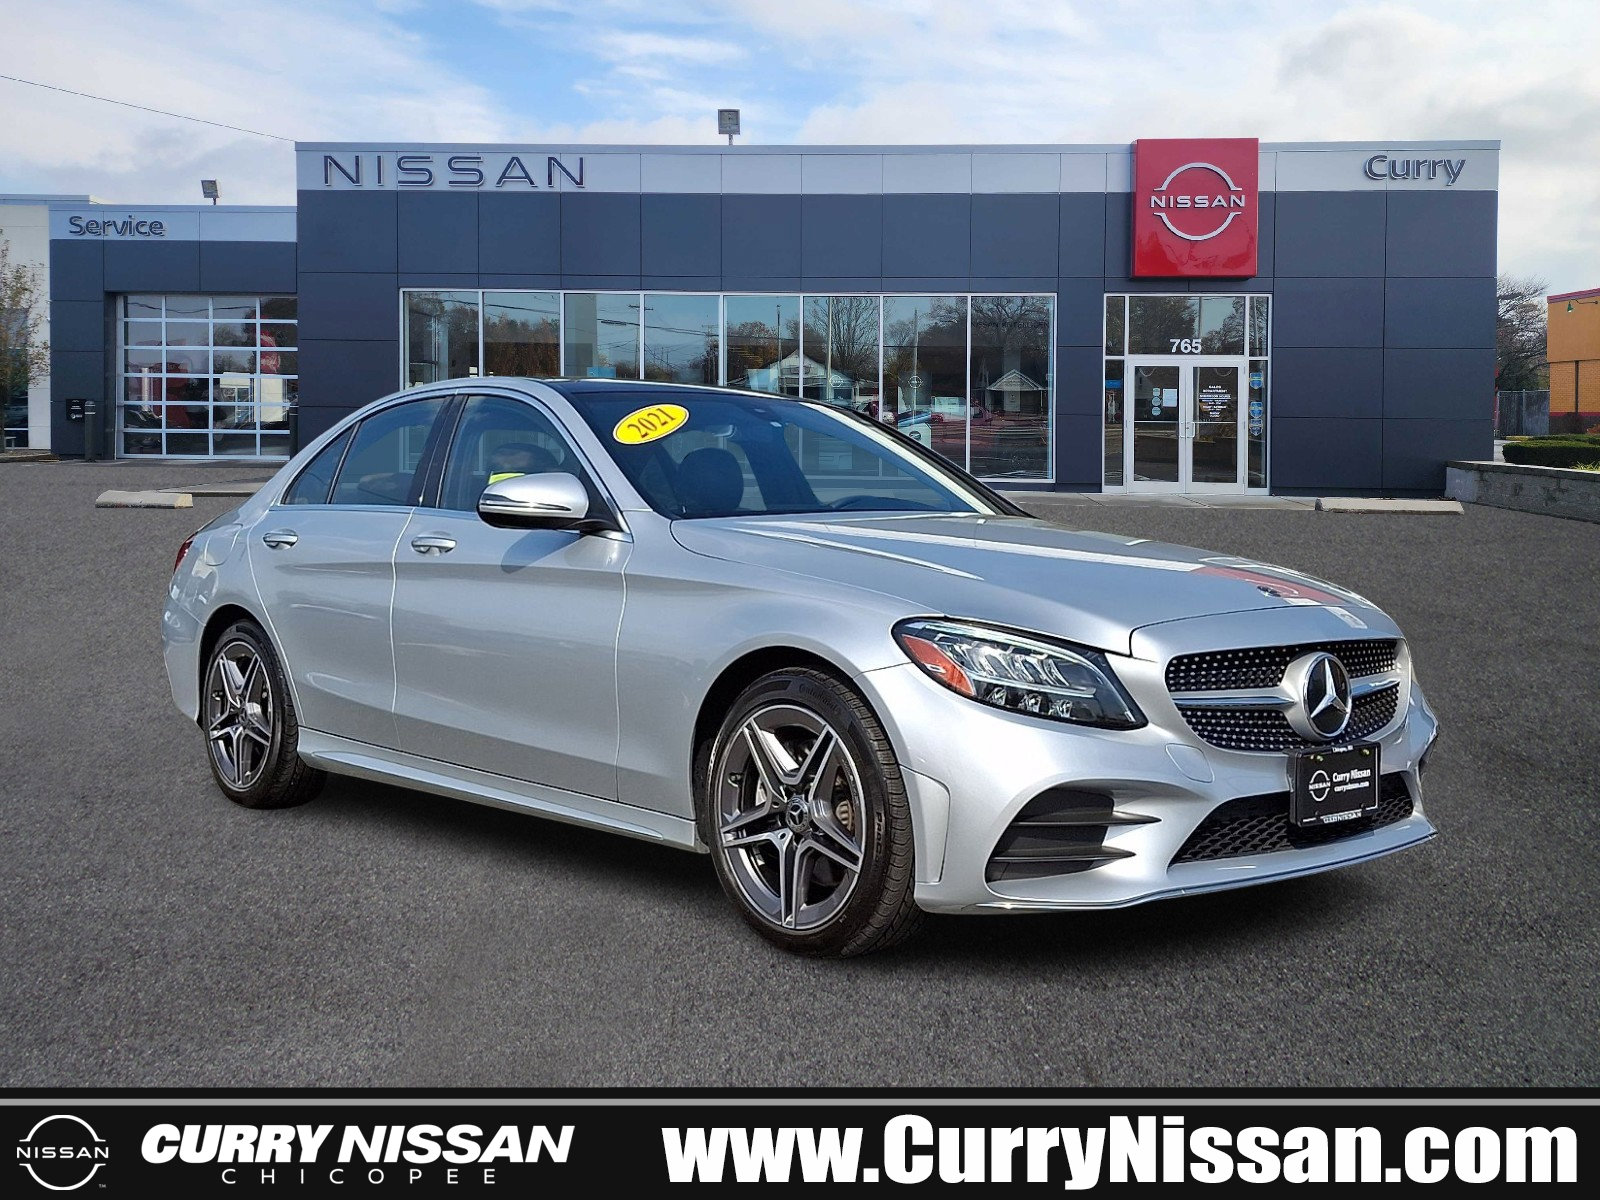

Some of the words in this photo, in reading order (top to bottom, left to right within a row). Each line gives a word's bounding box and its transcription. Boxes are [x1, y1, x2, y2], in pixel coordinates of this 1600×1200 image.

[323, 155, 586, 188] NISSAN
[1364, 154, 1466, 187] Curry
[1150, 194, 1246, 208] NISSAN
[68, 213, 165, 237] Service
[1169, 338, 1202, 354] 765
[627, 408, 676, 438] 2021
[1333, 773, 1350, 782] Curry
[1351, 769, 1371, 779] Nissan
[1309, 782, 1331, 790] NISSAN
